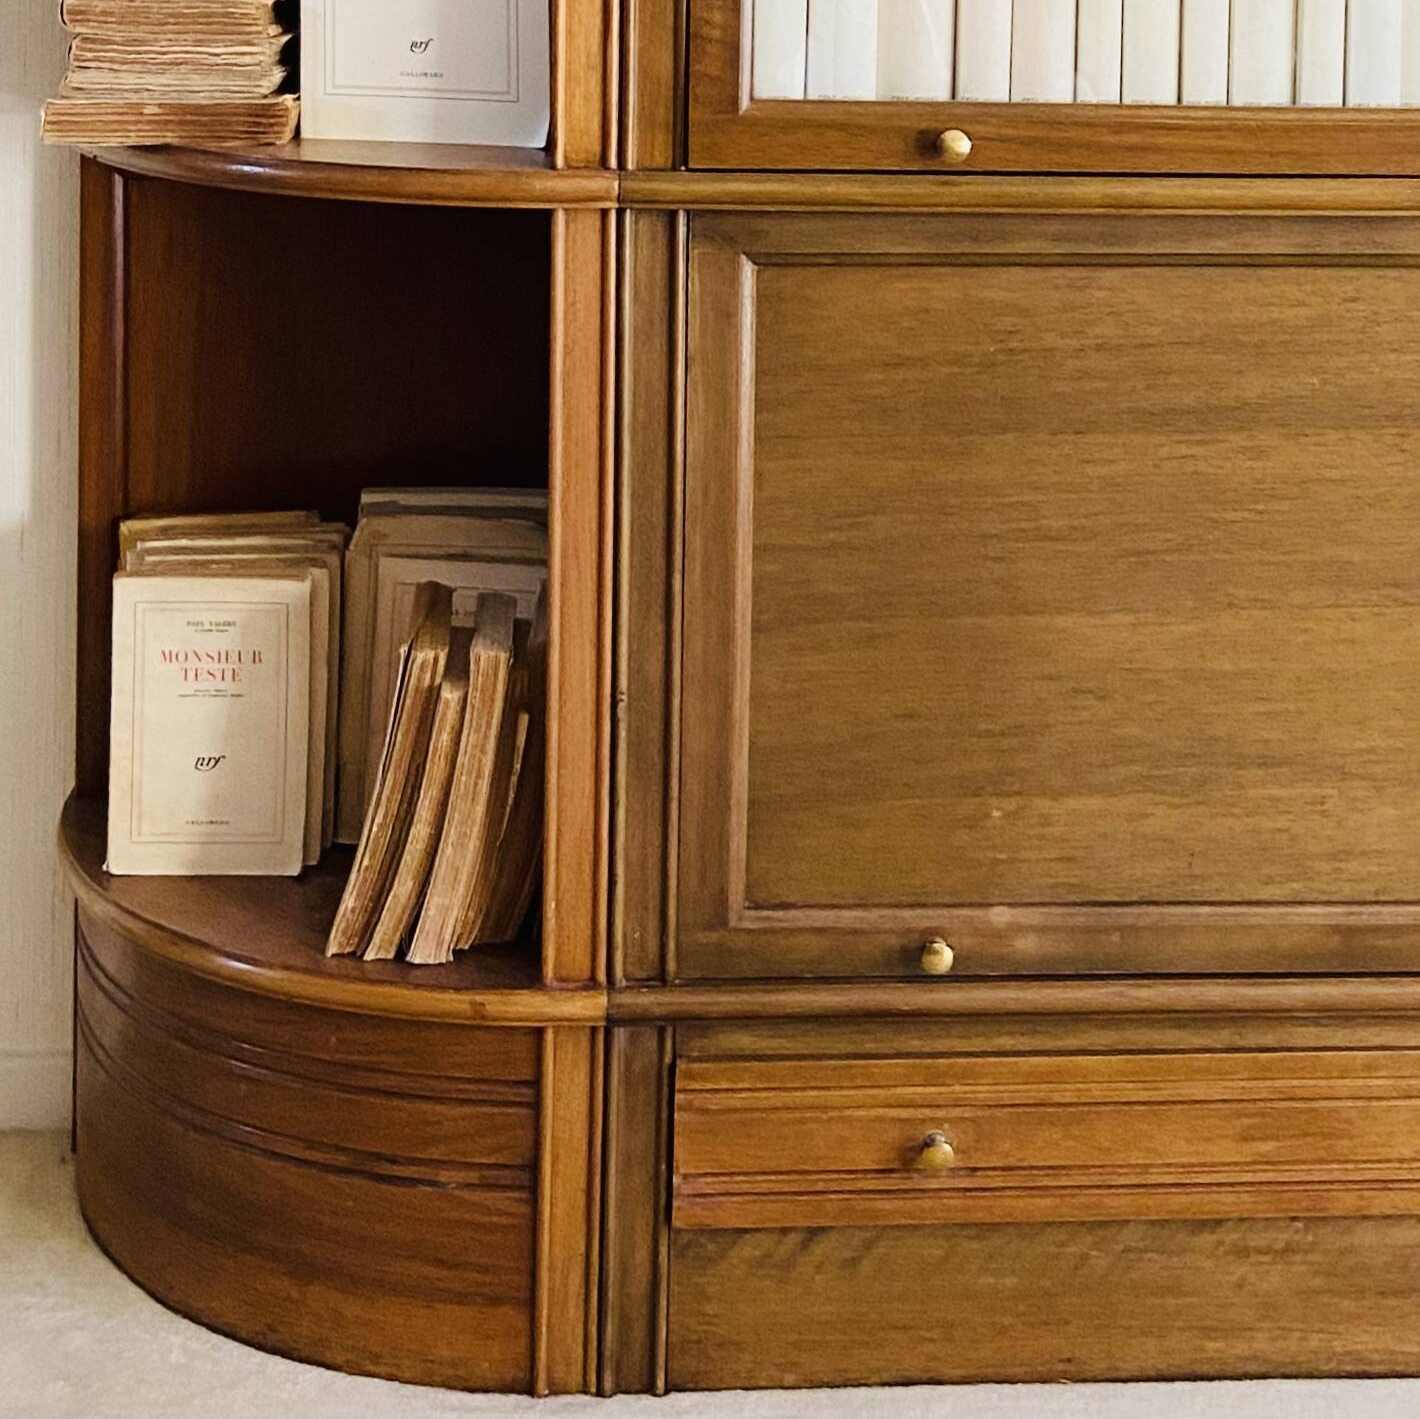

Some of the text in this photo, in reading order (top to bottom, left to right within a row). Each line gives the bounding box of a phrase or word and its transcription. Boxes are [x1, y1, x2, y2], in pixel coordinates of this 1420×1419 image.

[410, 38, 434, 53] nrf
[160, 649, 263, 664] MONSIEUR
[179, 667, 243, 682] TESTE
[194, 755, 226, 771] nrf
